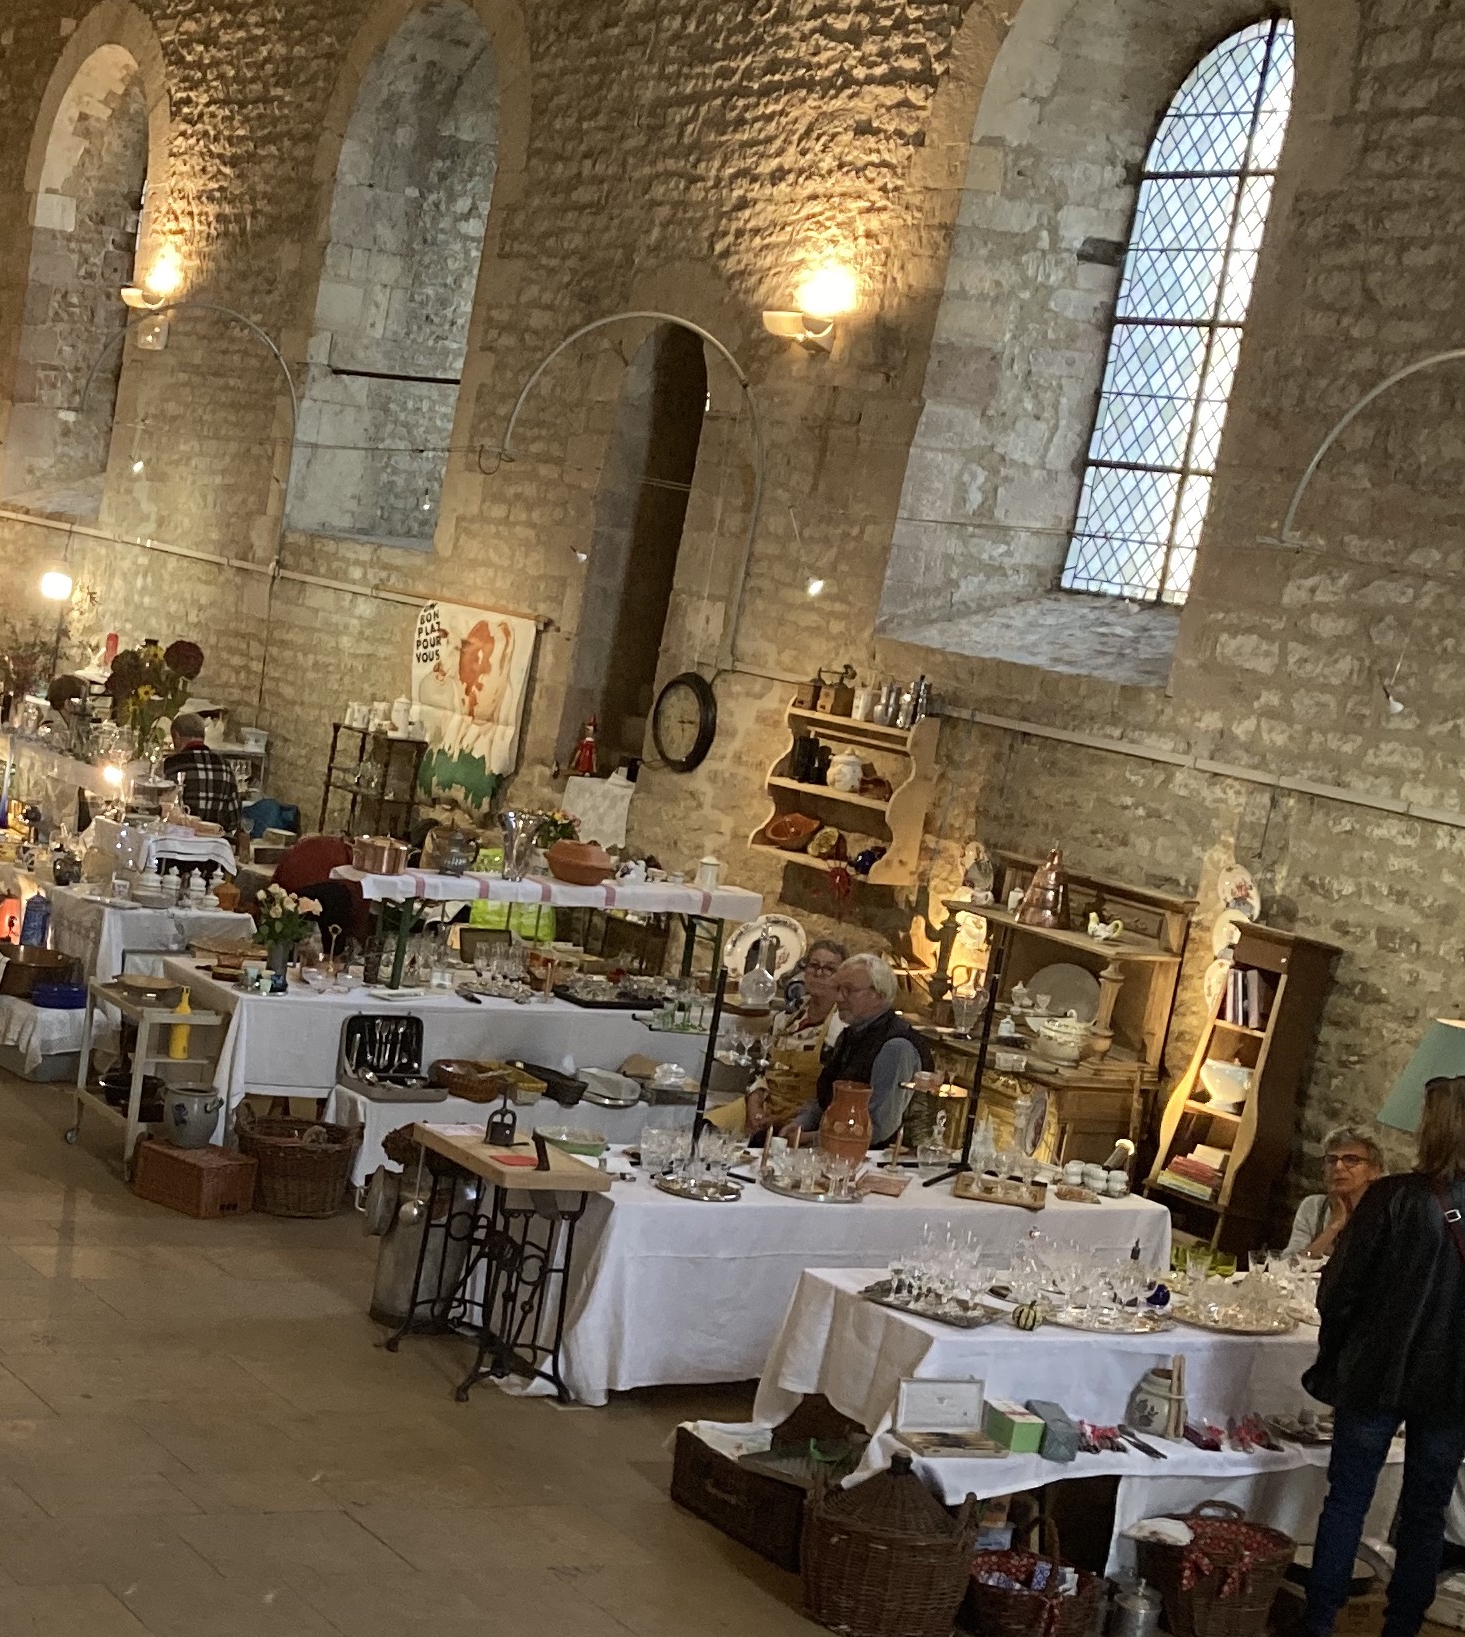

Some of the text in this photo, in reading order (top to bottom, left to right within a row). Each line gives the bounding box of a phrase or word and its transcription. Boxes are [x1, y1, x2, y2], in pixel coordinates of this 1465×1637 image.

[420, 609, 439, 625] BON
[416, 635, 441, 650] POUR
[416, 649, 440, 663] VOUS
